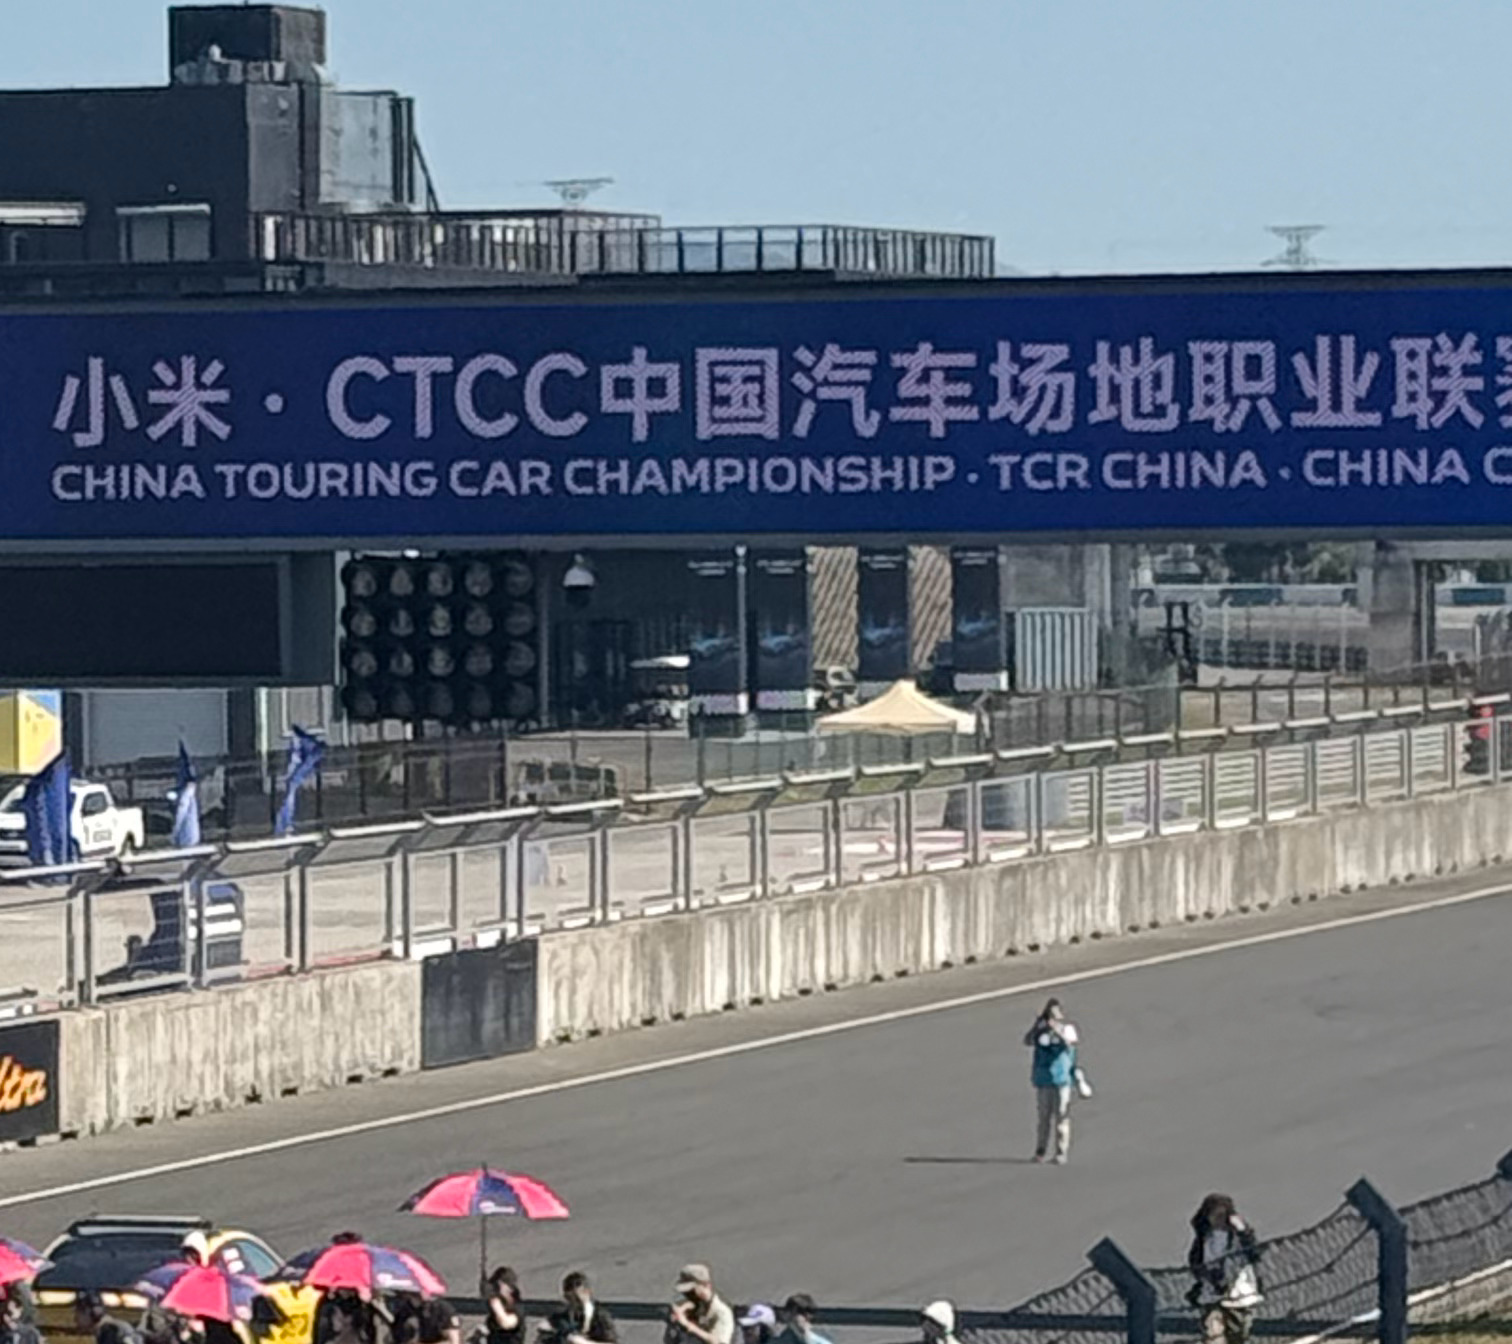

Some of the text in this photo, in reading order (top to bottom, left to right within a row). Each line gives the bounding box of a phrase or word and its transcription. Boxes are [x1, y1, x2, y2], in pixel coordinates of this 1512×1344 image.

[53, 354, 232, 447] 小米
[325, 332, 1512, 442] CTCC中国汽车场地职业联
[51, 462, 207, 501] CHINA
[213, 460, 439, 500] TOURING
[448, 459, 552, 498] CAR
[563, 454, 956, 497] CHAMPIONSHIP
[988, 453, 1091, 492] TCR
[1101, 449, 1268, 490] CHINA
[1302, 446, 1471, 487] CHINA
